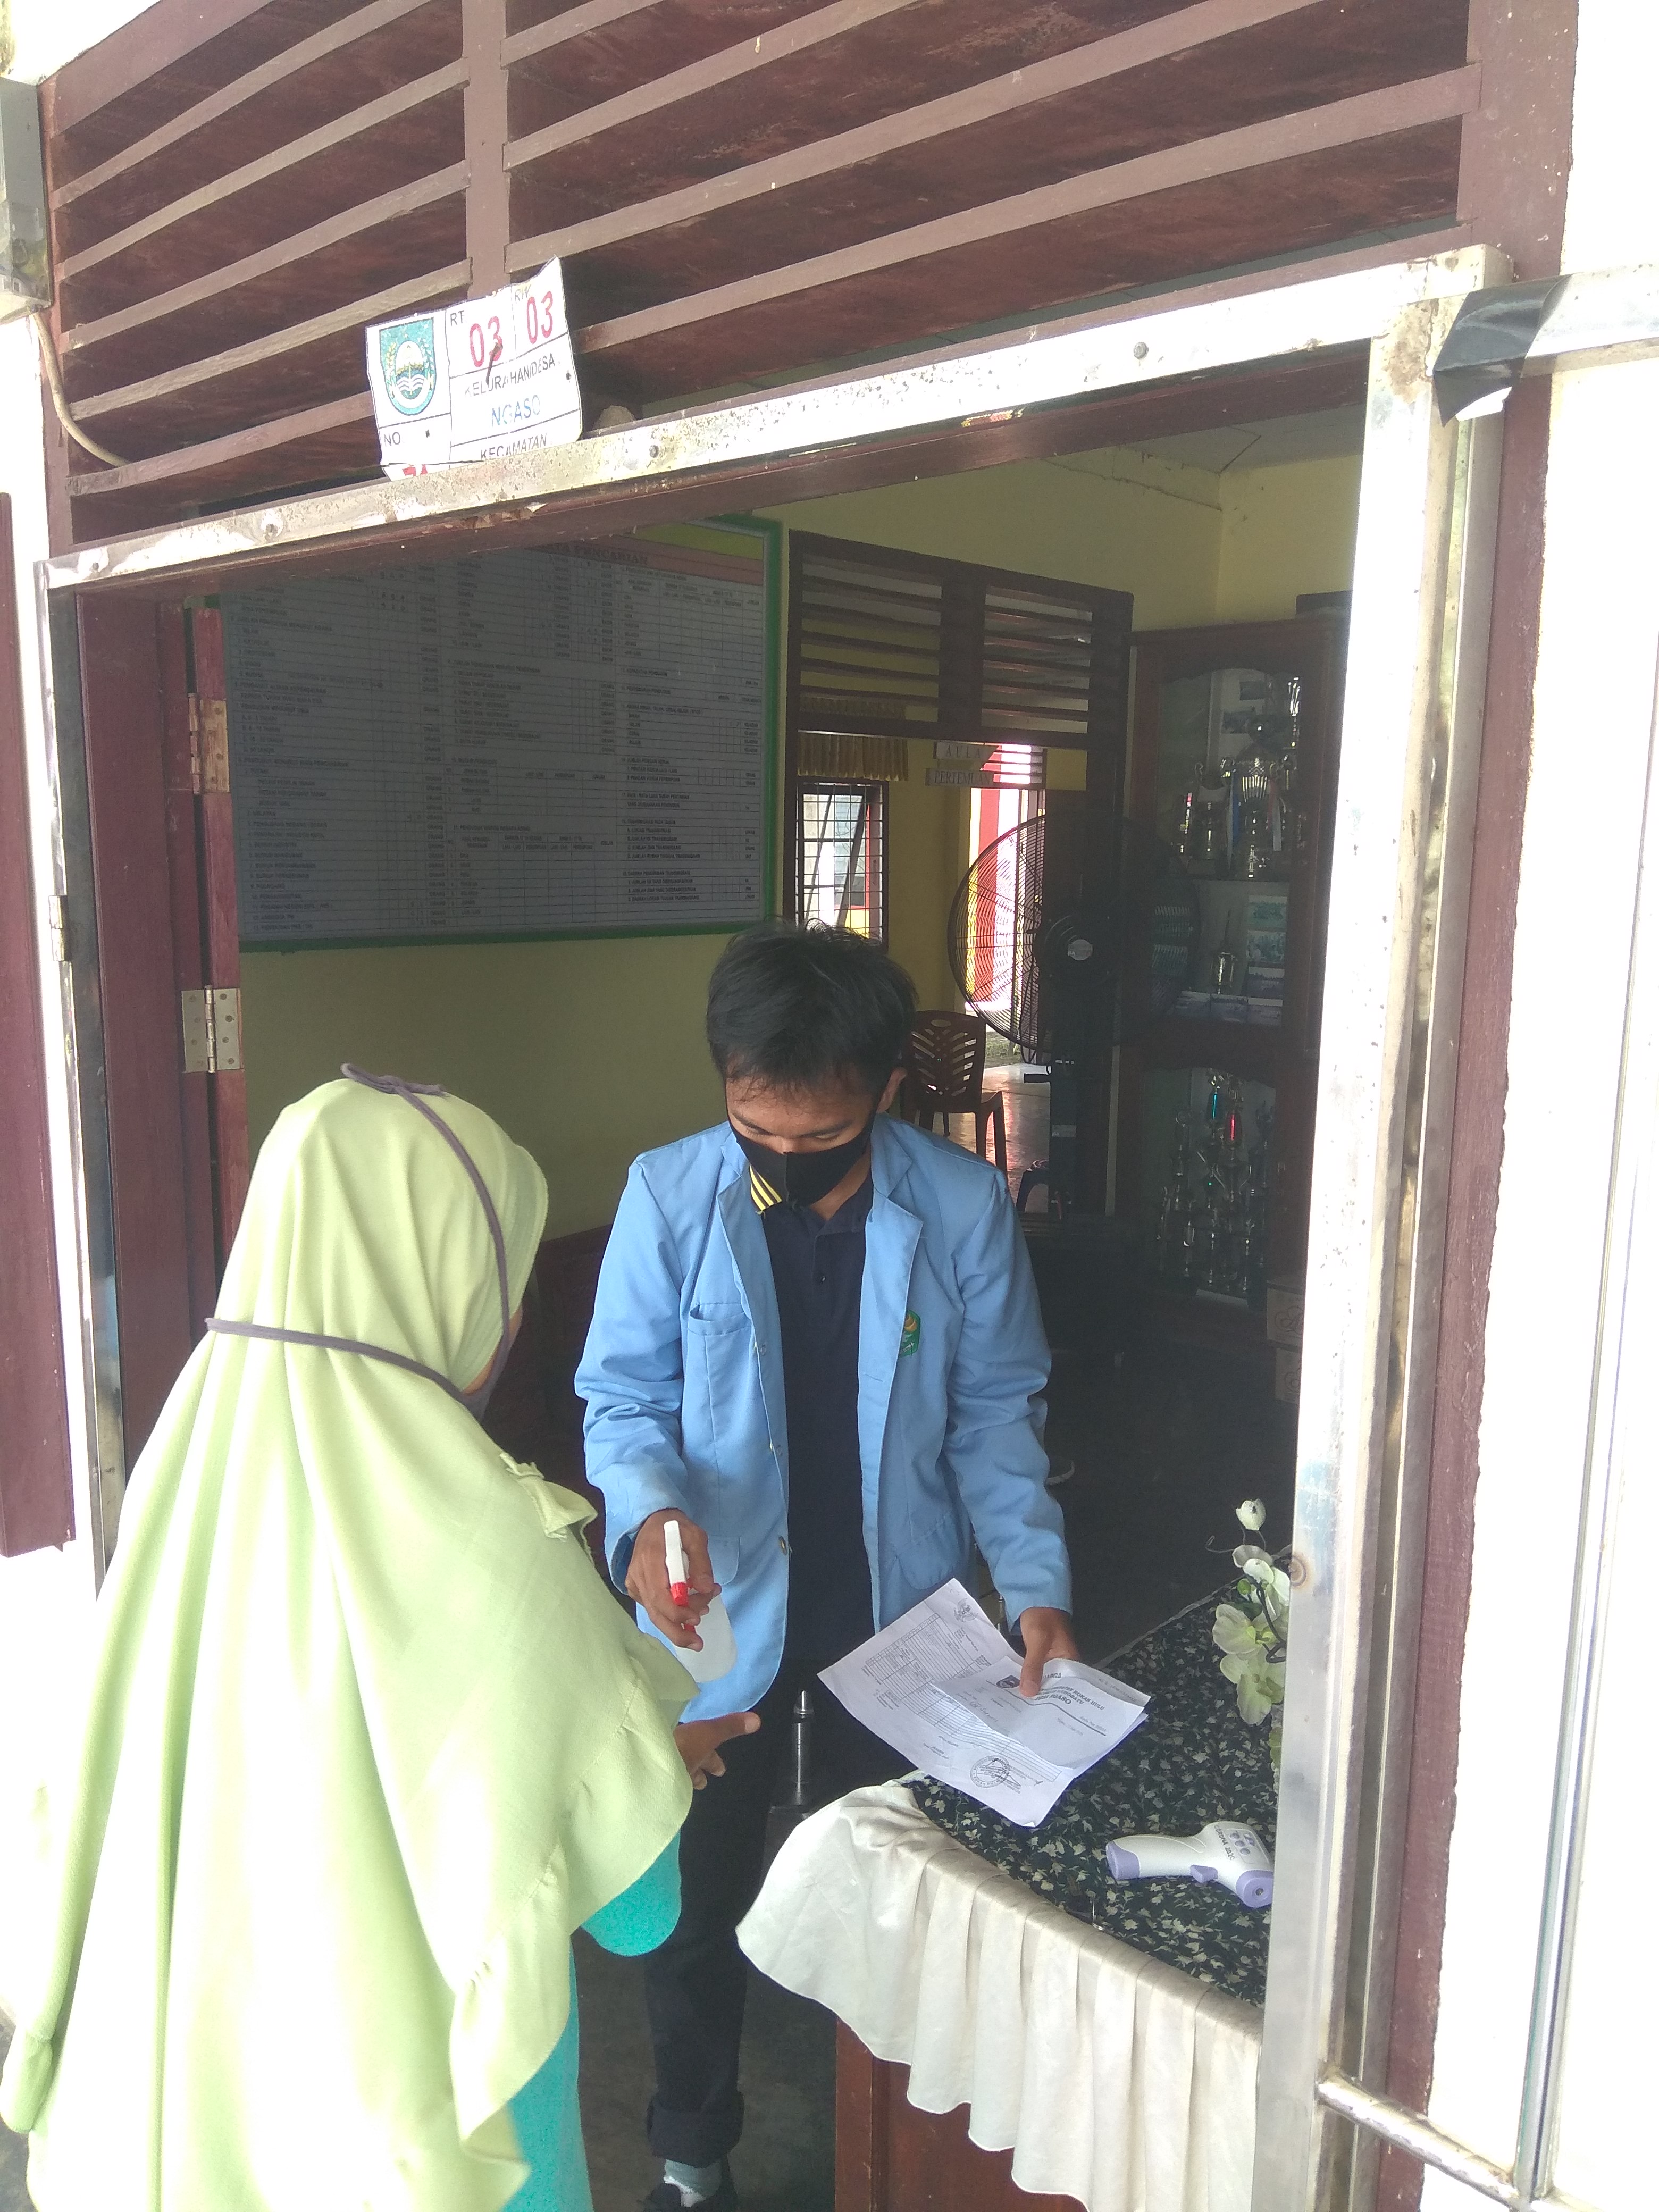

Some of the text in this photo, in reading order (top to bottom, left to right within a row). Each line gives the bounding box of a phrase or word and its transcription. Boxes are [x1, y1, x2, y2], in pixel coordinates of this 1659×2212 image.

[526, 290, 554, 345] 03
[469, 316, 503, 368] 03
[491, 395, 541, 427] NGASO
[481, 432, 547, 460] KECAMATAN
[946, 744, 981, 758] AULA
[935, 770, 990, 785] PERTEMUAN
[1050, 1694, 1072, 1705] NGASO
[1073, 1688, 1091, 1703] ROKAN
[1090, 1700, 1105, 1711] HULU
[1214, 1824, 1228, 1846] CORONA
